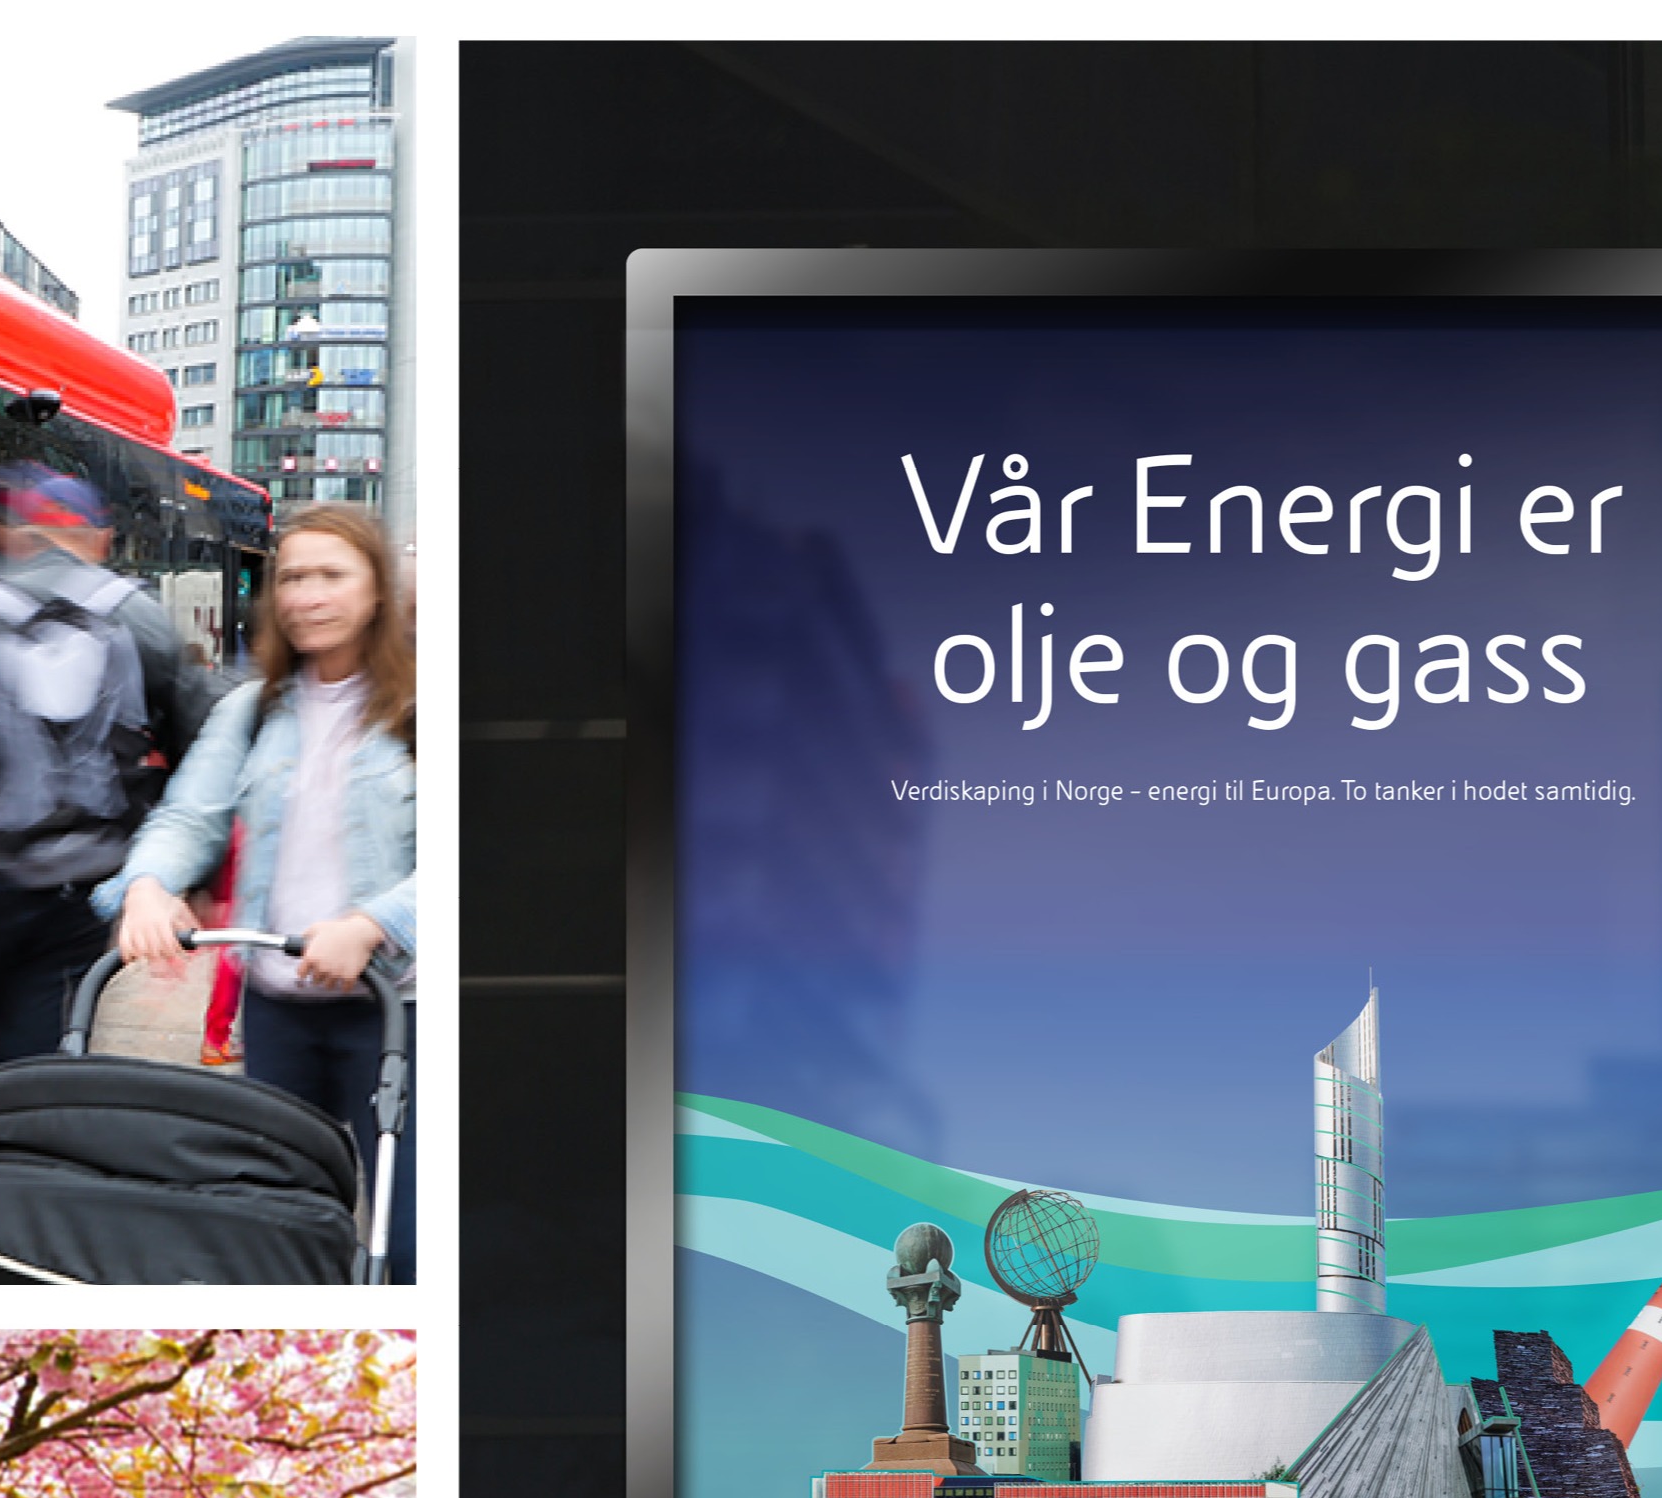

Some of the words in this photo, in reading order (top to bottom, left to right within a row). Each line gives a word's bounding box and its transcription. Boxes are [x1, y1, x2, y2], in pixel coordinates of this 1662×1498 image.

[900, 453, 1094, 555] Vår
[1136, 453, 1473, 582] Energi
[1519, 485, 1624, 555] er
[934, 602, 1124, 731] olje
[1167, 634, 1297, 731] og
[1344, 634, 1586, 731] gass
[890, 779, 1035, 806] Verdiskaping
[1042, 779, 1048, 801] i
[1056, 779, 1124, 806] Norge
[1147, 779, 1217, 806] energi
[1225, 779, 1243, 801] til
[1252, 779, 1336, 806] Europa.
[1340, 779, 1367, 801] To
[1375, 779, 1445, 801] tanker
[1451, 779, 1456, 801] i
[1464, 779, 1528, 801] hodet
[1534, 779, 1636, 806] samtidig.
